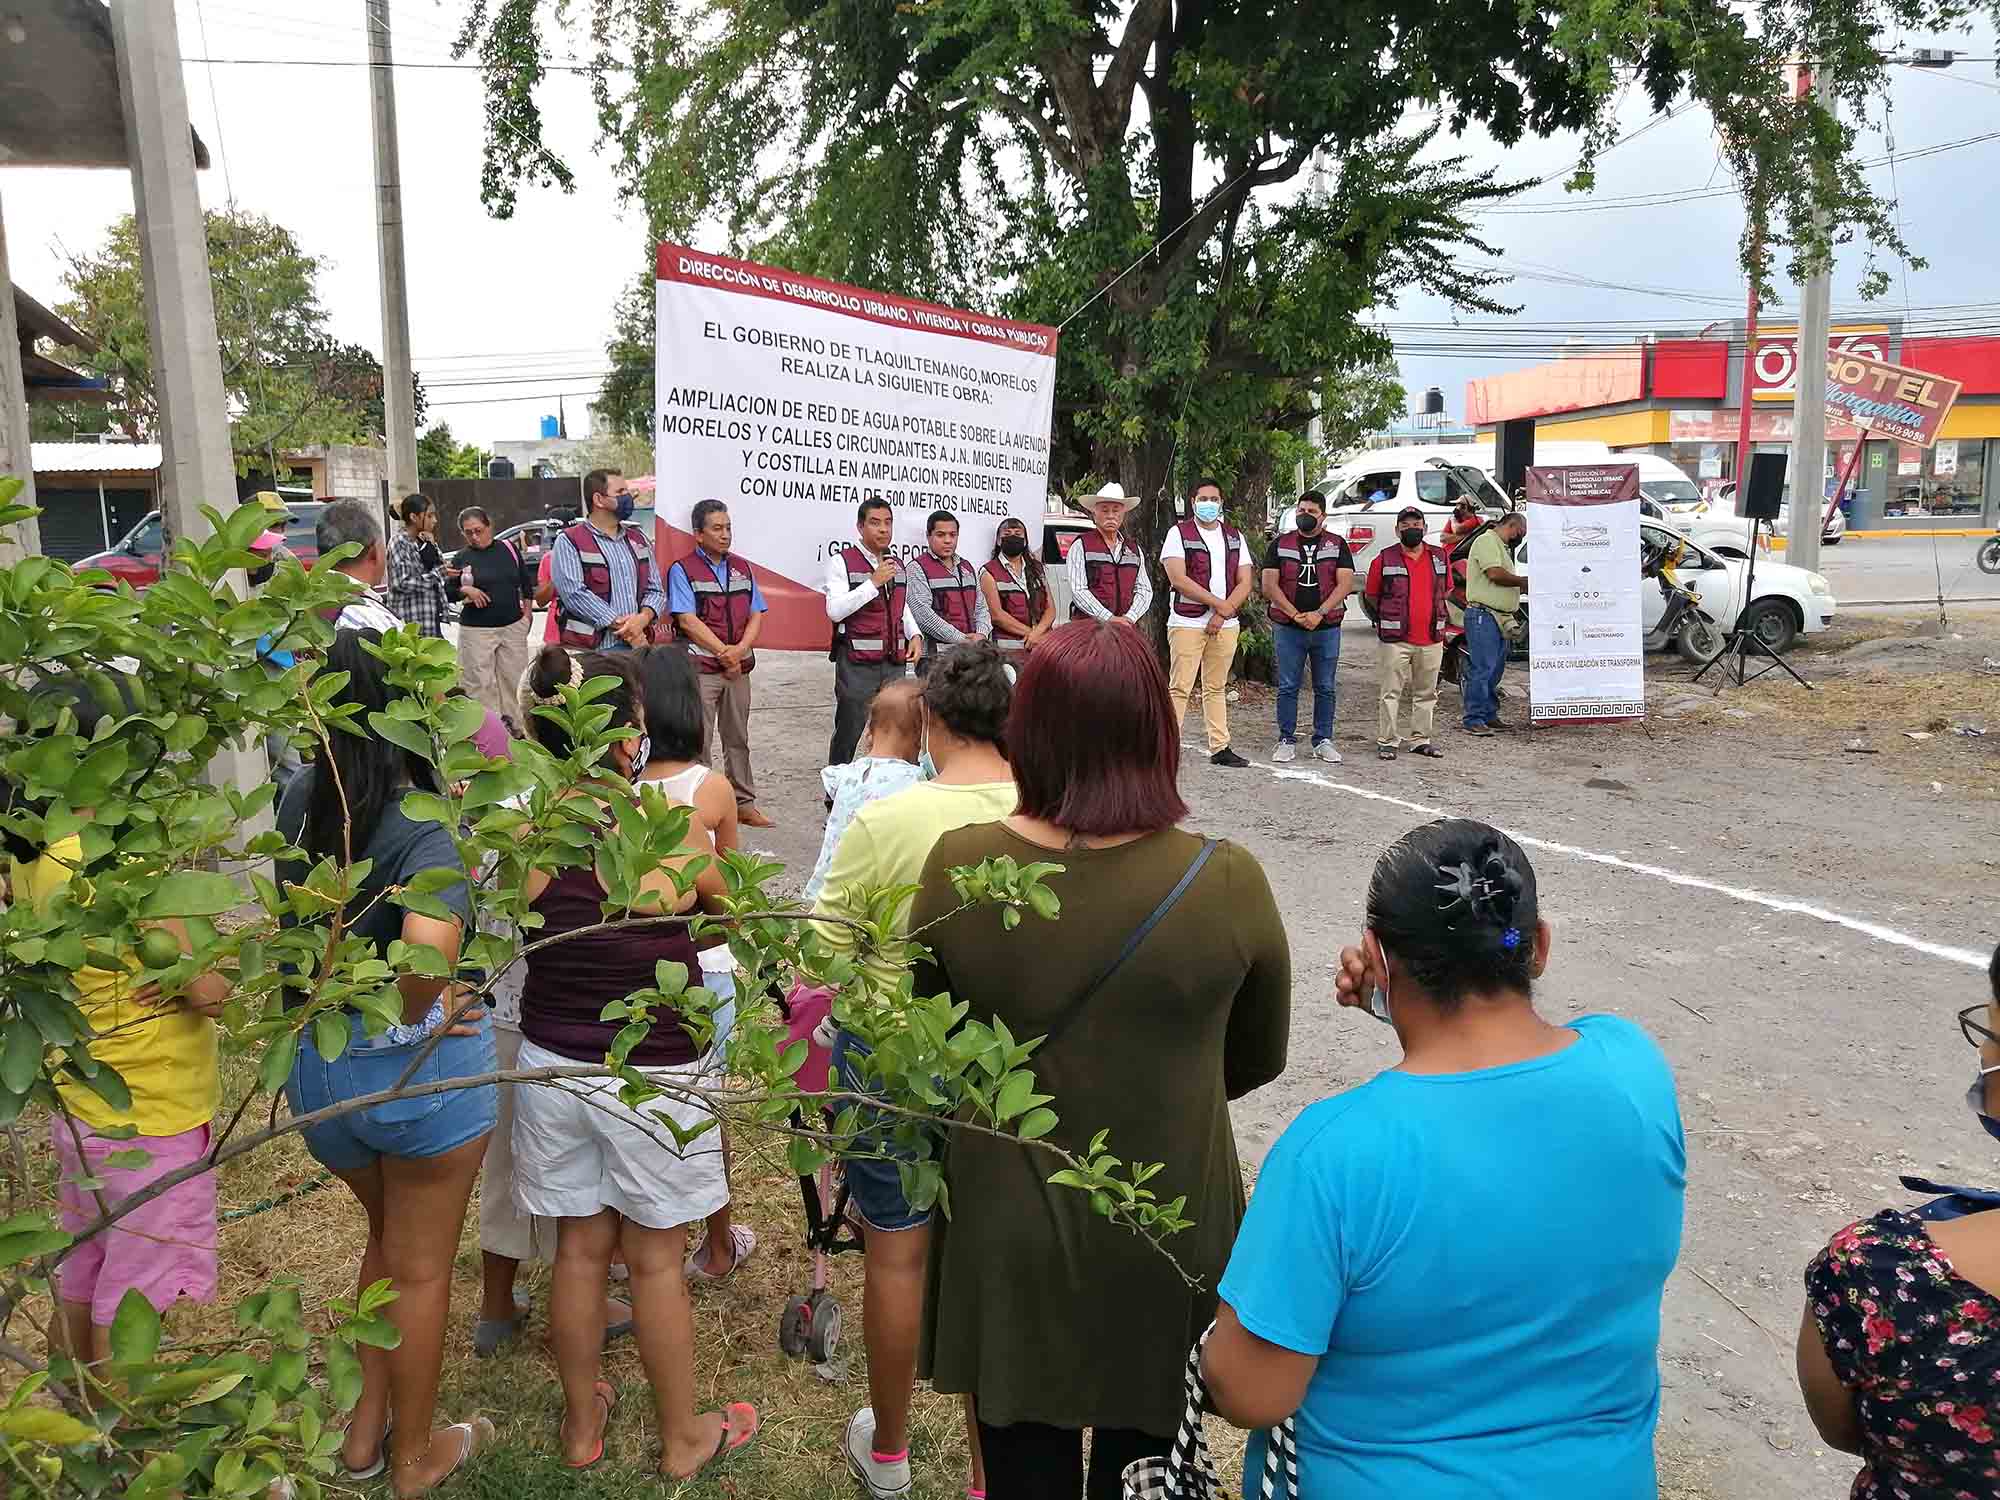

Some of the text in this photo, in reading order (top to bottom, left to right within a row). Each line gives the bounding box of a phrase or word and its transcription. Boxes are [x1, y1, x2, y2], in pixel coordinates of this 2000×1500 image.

[679, 257, 761, 289] DIRECCIÓN
[763, 278, 781, 293] DE
[783, 280, 860, 311] DESARROLLO
[863, 299, 912, 324] URBANO,
[913, 309, 962, 332] VIVIENDA
[962, 320, 970, 333] Y
[972, 322, 1006, 339] OBRAS
[704, 321, 727, 340] EL
[733, 326, 824, 355] GOBIERNO
[831, 341, 851, 359] DE
[782, 357, 993, 405] REALIZA LA SIGUIENTE OBRA:
[1826, 357, 1938, 409] HOTEL
[667, 387, 1047, 454] AMPLIACION DE RED DE AGUA POTABLE SOBRE LA AVENIDA
[663, 414, 1047, 476] MORELOS Y CALLES CIRCUNDANTES A J.N. MIGUEL HIDALGO
[742, 450, 1012, 494] Y COSTILLA EN AMPLIACION PRESIDENTES
[740, 477, 777, 497] CON
[783, 481, 815, 501] UNA
[820, 485, 859, 504] META
[886, 489, 904, 507] 500
[909, 492, 957, 512] METROS
[961, 497, 1010, 517] LINEALES.
[1541, 660, 1556, 669] CUNA
[1557, 660, 1567, 669] DE
[1600, 659, 1607, 668] SE
